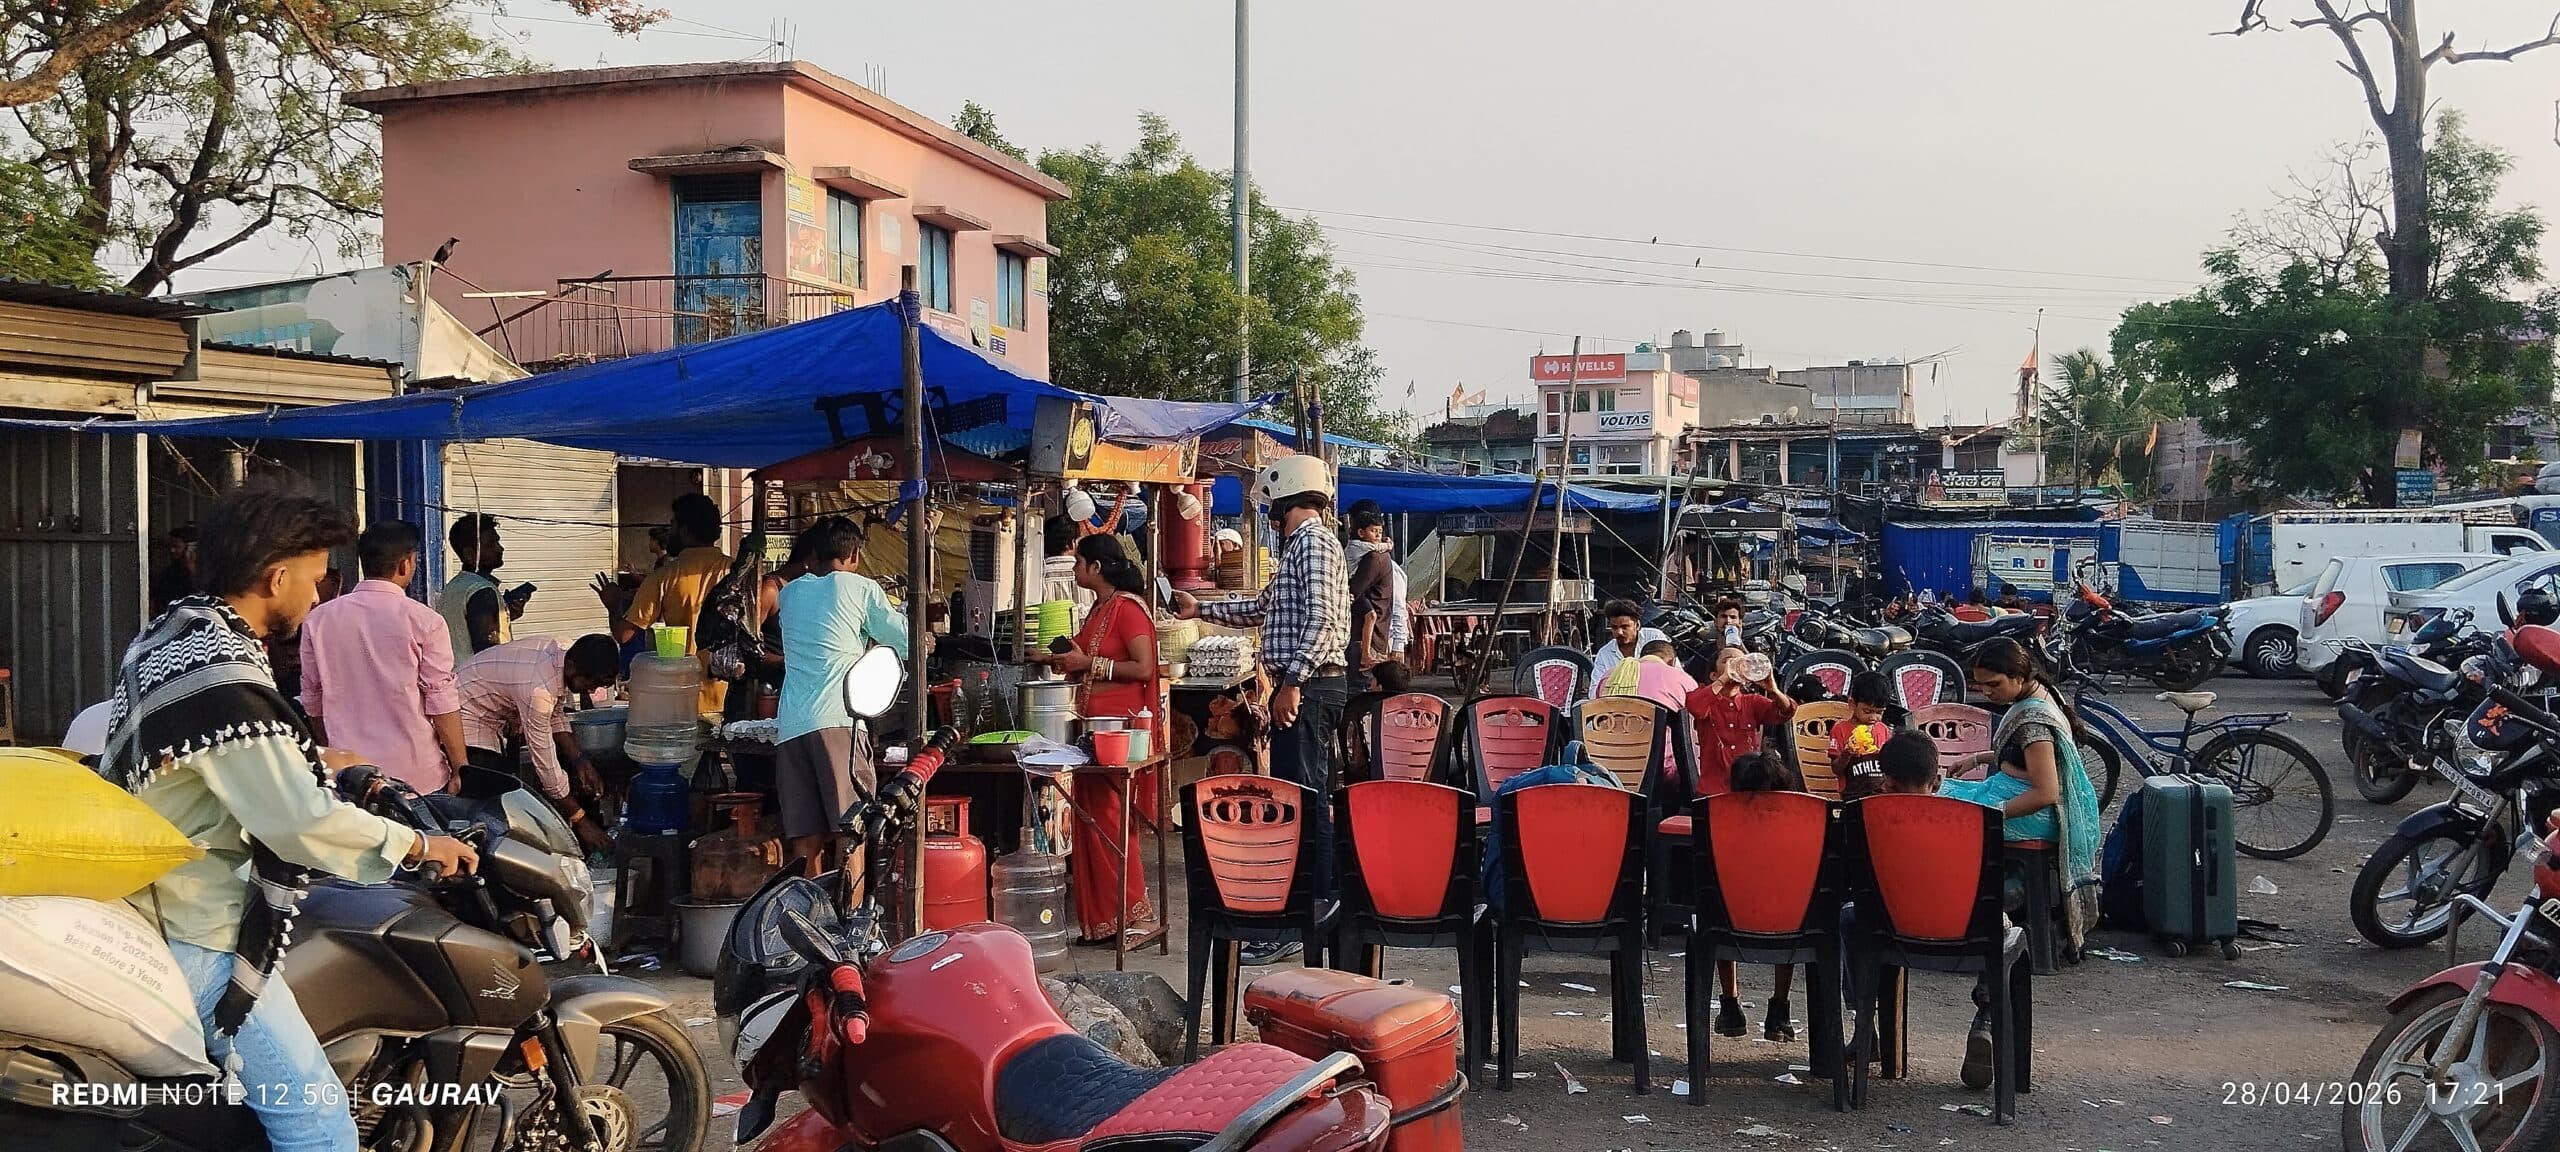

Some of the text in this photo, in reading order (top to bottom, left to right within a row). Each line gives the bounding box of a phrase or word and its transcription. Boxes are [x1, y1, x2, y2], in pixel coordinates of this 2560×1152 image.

[1562, 361, 1615, 372] HVELLS
[1600, 414, 1650, 426] VOLTAS
[2012, 557, 2026, 568] R
[2033, 558, 2046, 568] U
[91, 945, 126, 971] Before
[127, 962, 136, 975] 3
